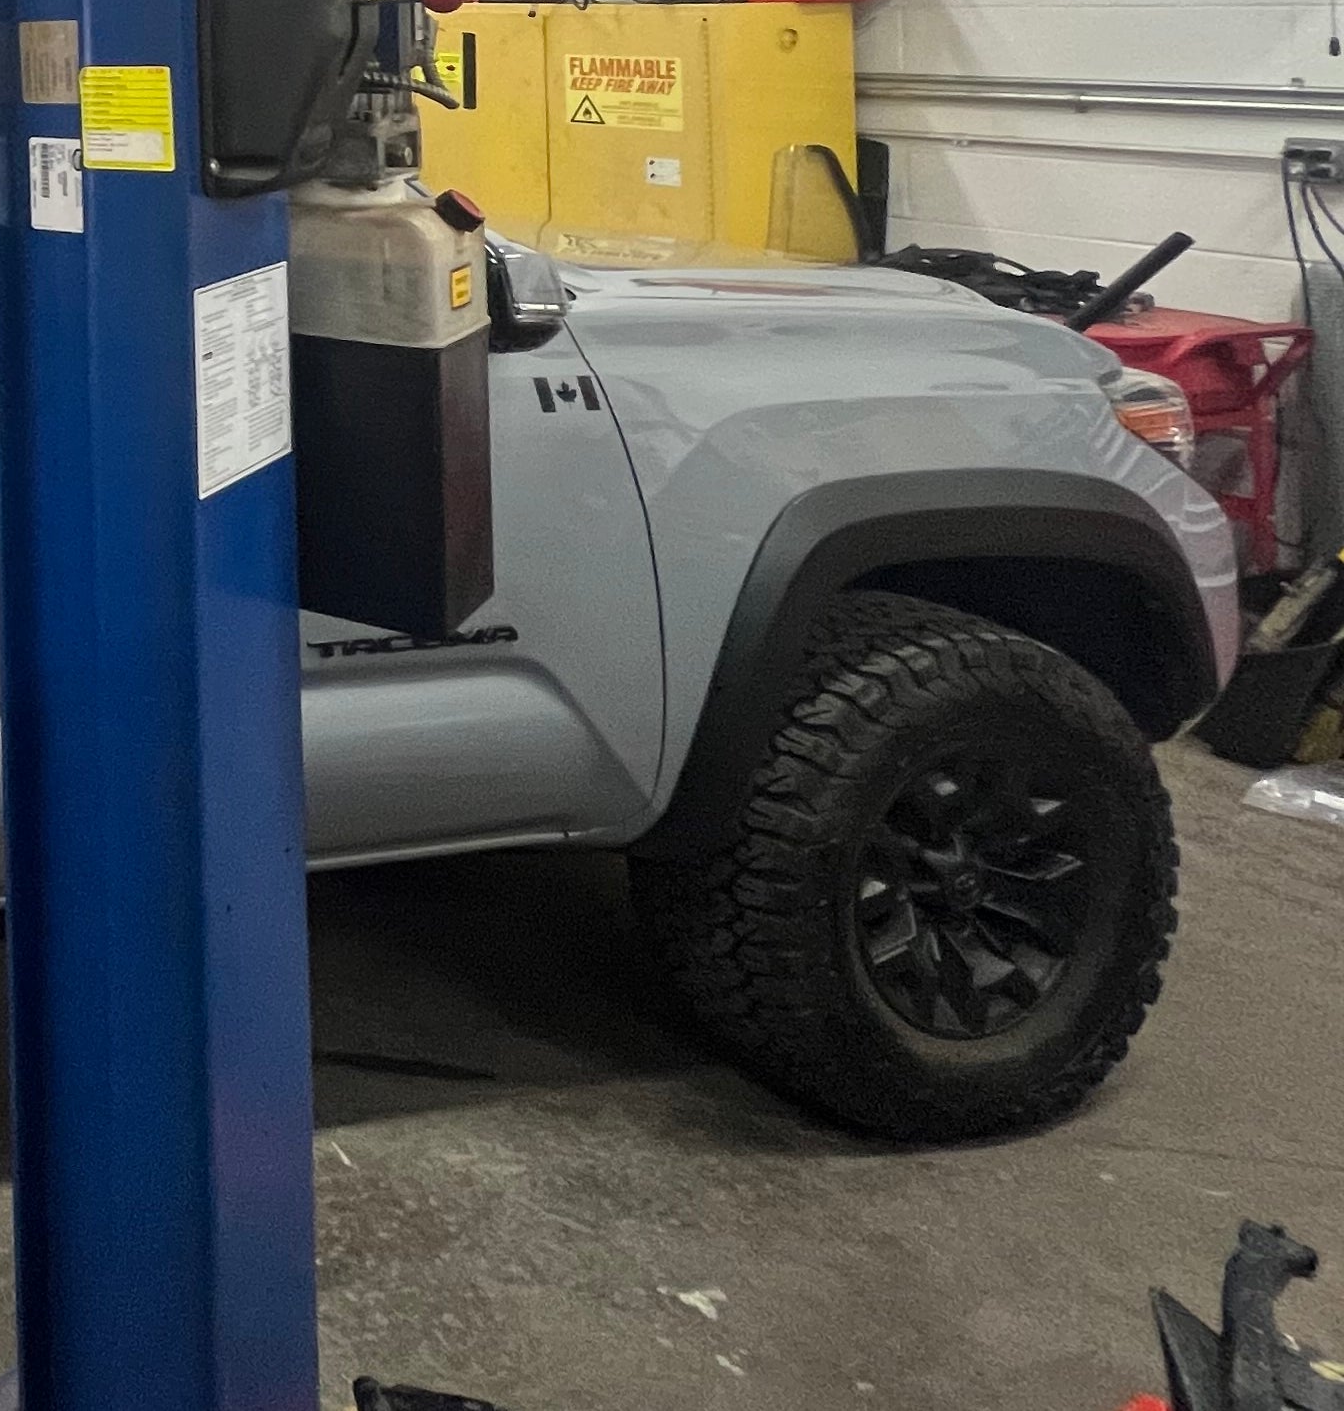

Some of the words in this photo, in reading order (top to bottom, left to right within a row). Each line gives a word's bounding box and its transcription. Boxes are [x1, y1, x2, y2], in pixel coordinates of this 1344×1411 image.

[569, 57, 676, 79] FLAMMABLE
[570, 76, 603, 91] KEEP
[605, 78, 635, 93] FIRE
[635, 80, 677, 95] AWAY
